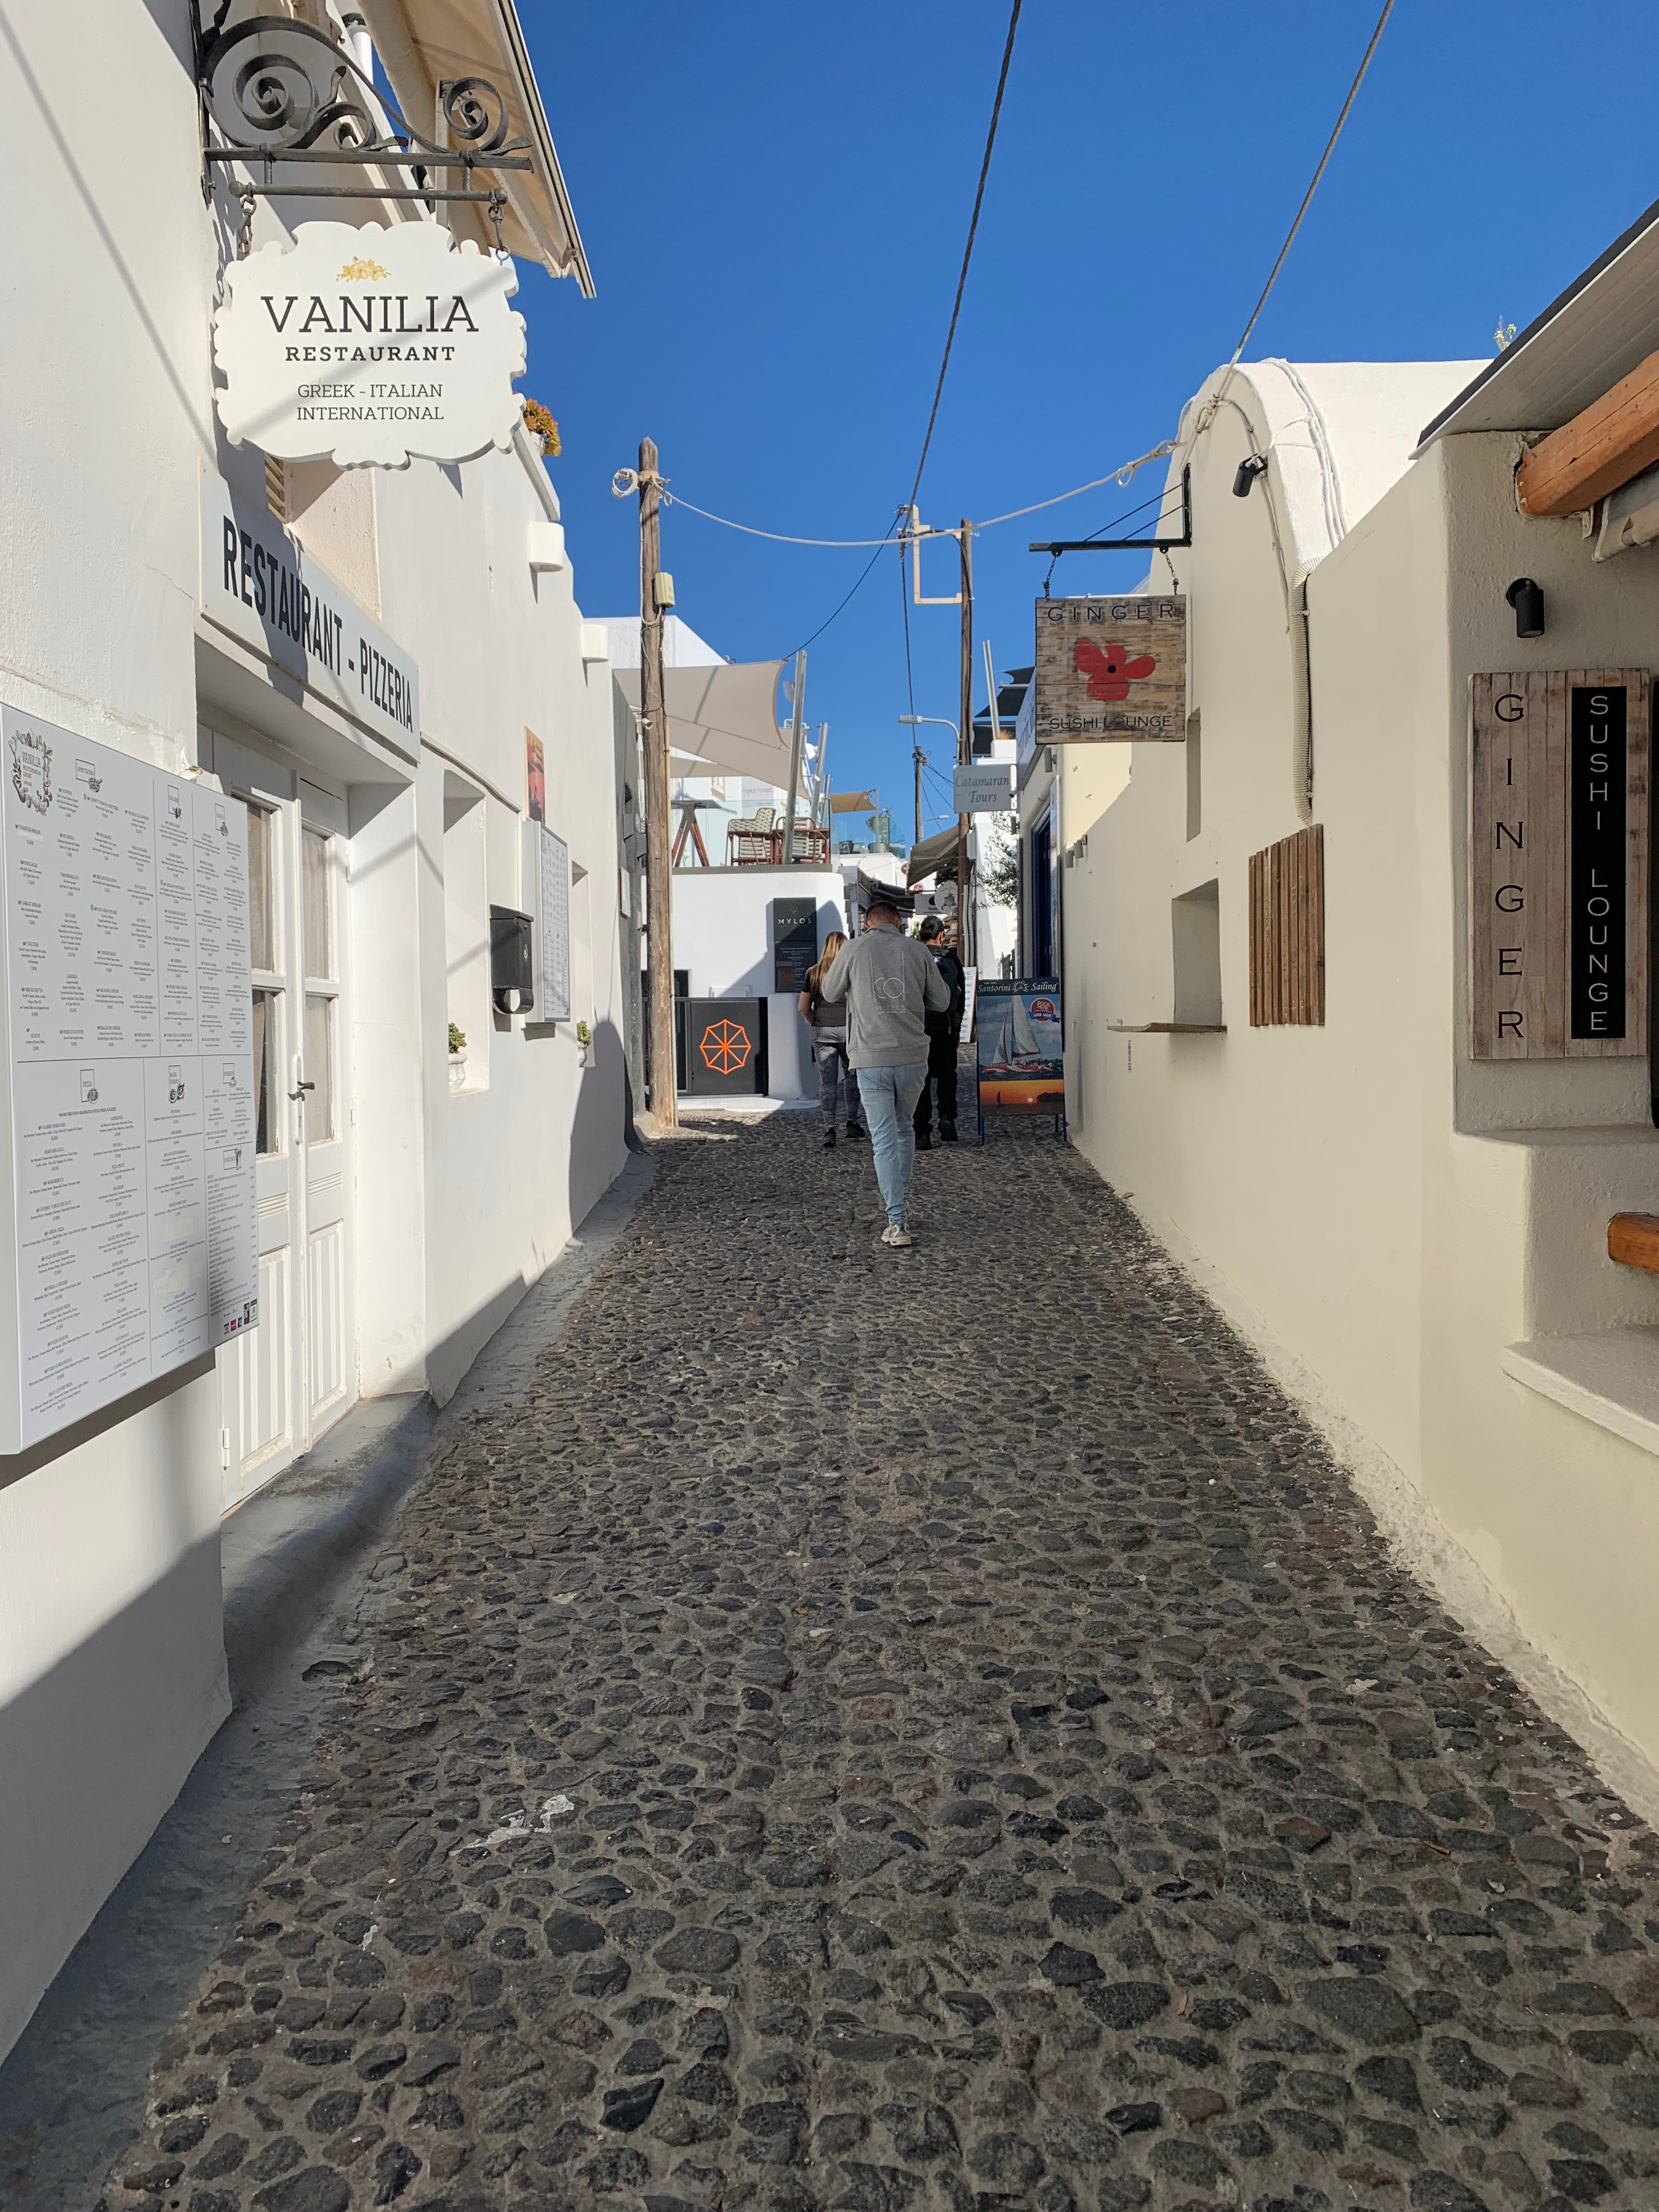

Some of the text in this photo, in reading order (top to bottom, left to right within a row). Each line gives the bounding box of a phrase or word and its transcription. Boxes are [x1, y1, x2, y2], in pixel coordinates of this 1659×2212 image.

[261, 296, 479, 332] VANILIA
[285, 347, 455, 362] RESTAURANT
[297, 384, 354, 398] GREEK
[370, 384, 442, 398] ITALIAN
[297, 407, 444, 421] INTERNATIONAL
[1048, 603, 1173, 621] GINGER
[223, 515, 342, 676] RESTAURANT
[360, 636, 413, 733] PIZZERIA
[1049, 715, 1172, 730] SUSHI LOUNGE
[22, 751, 41, 768] VANILIA
[955, 775, 1010, 787] Catamaran
[968, 790, 997, 803] Tours
[1494, 693, 1525, 1039] GINGER
[1587, 695, 1610, 1031] SUSHI LOUNGE
[977, 981, 1057, 993] Santorini Sailing
